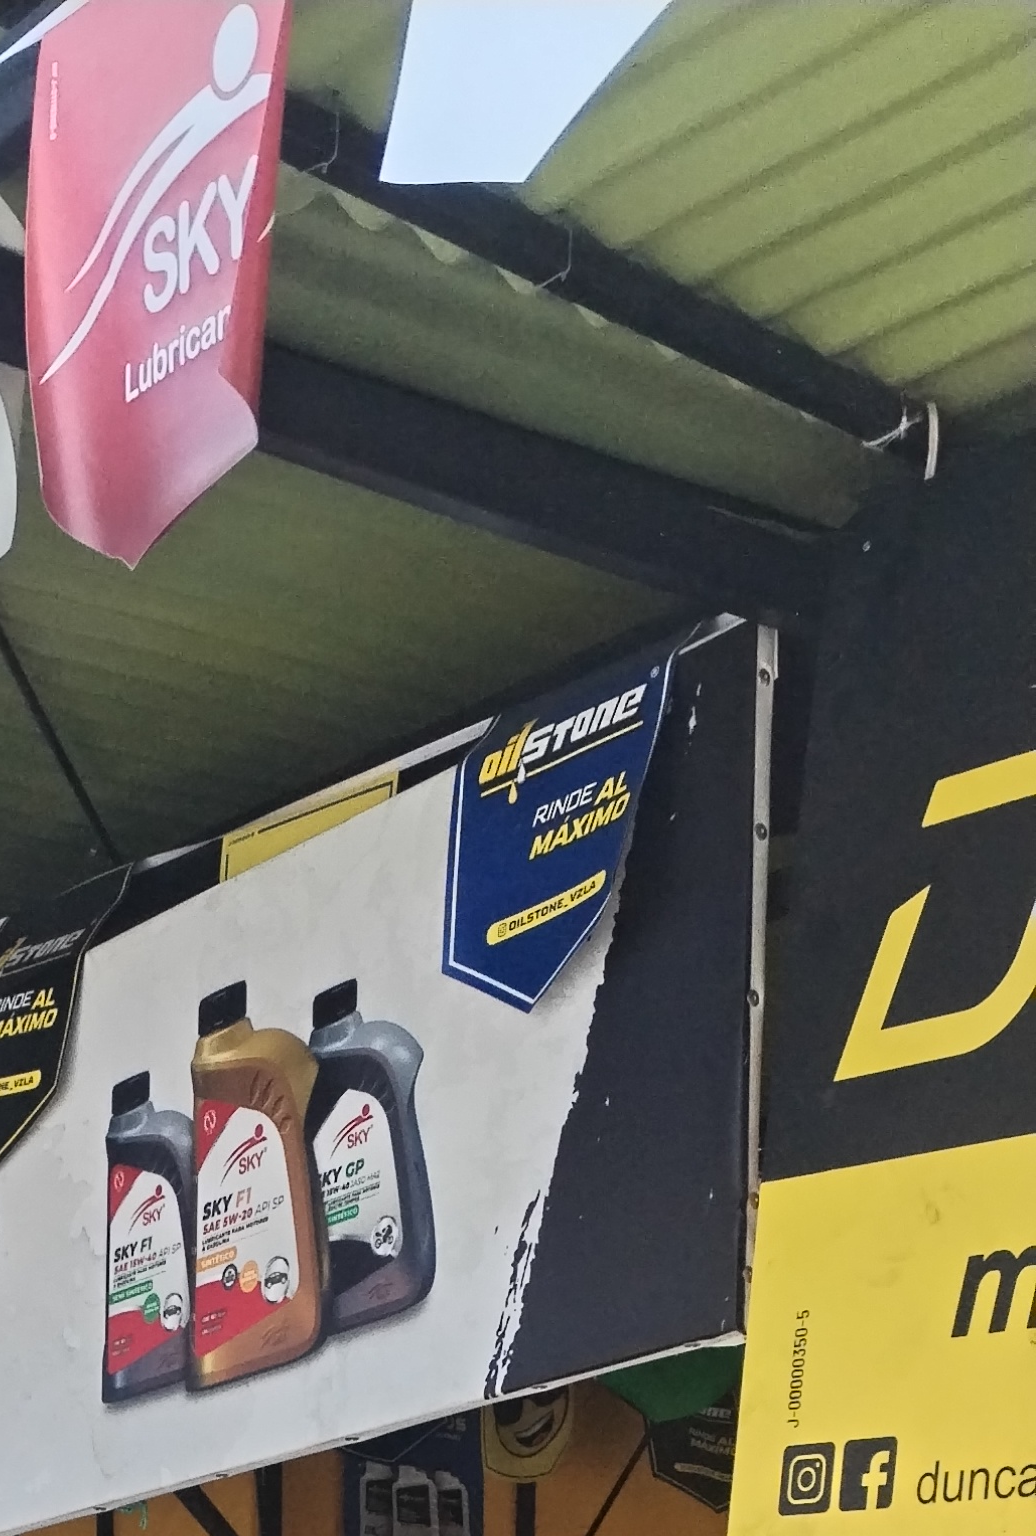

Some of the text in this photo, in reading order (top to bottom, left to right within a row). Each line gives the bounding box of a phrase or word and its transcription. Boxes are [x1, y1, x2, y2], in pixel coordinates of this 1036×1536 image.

[144, 155, 260, 314] SKY
[532, 770, 628, 828] RINDE AL
[528, 791, 631, 860] MÁXIMO
[31, 987, 56, 1010] AL
[238, 1153, 263, 1175] SKY
[346, 1158, 365, 1178] GP
[202, 1193, 233, 1222] SKY
[202, 1219, 221, 1236] SAE
[223, 1207, 254, 1228] 5W-20
[113, 1240, 139, 1264] SKY
